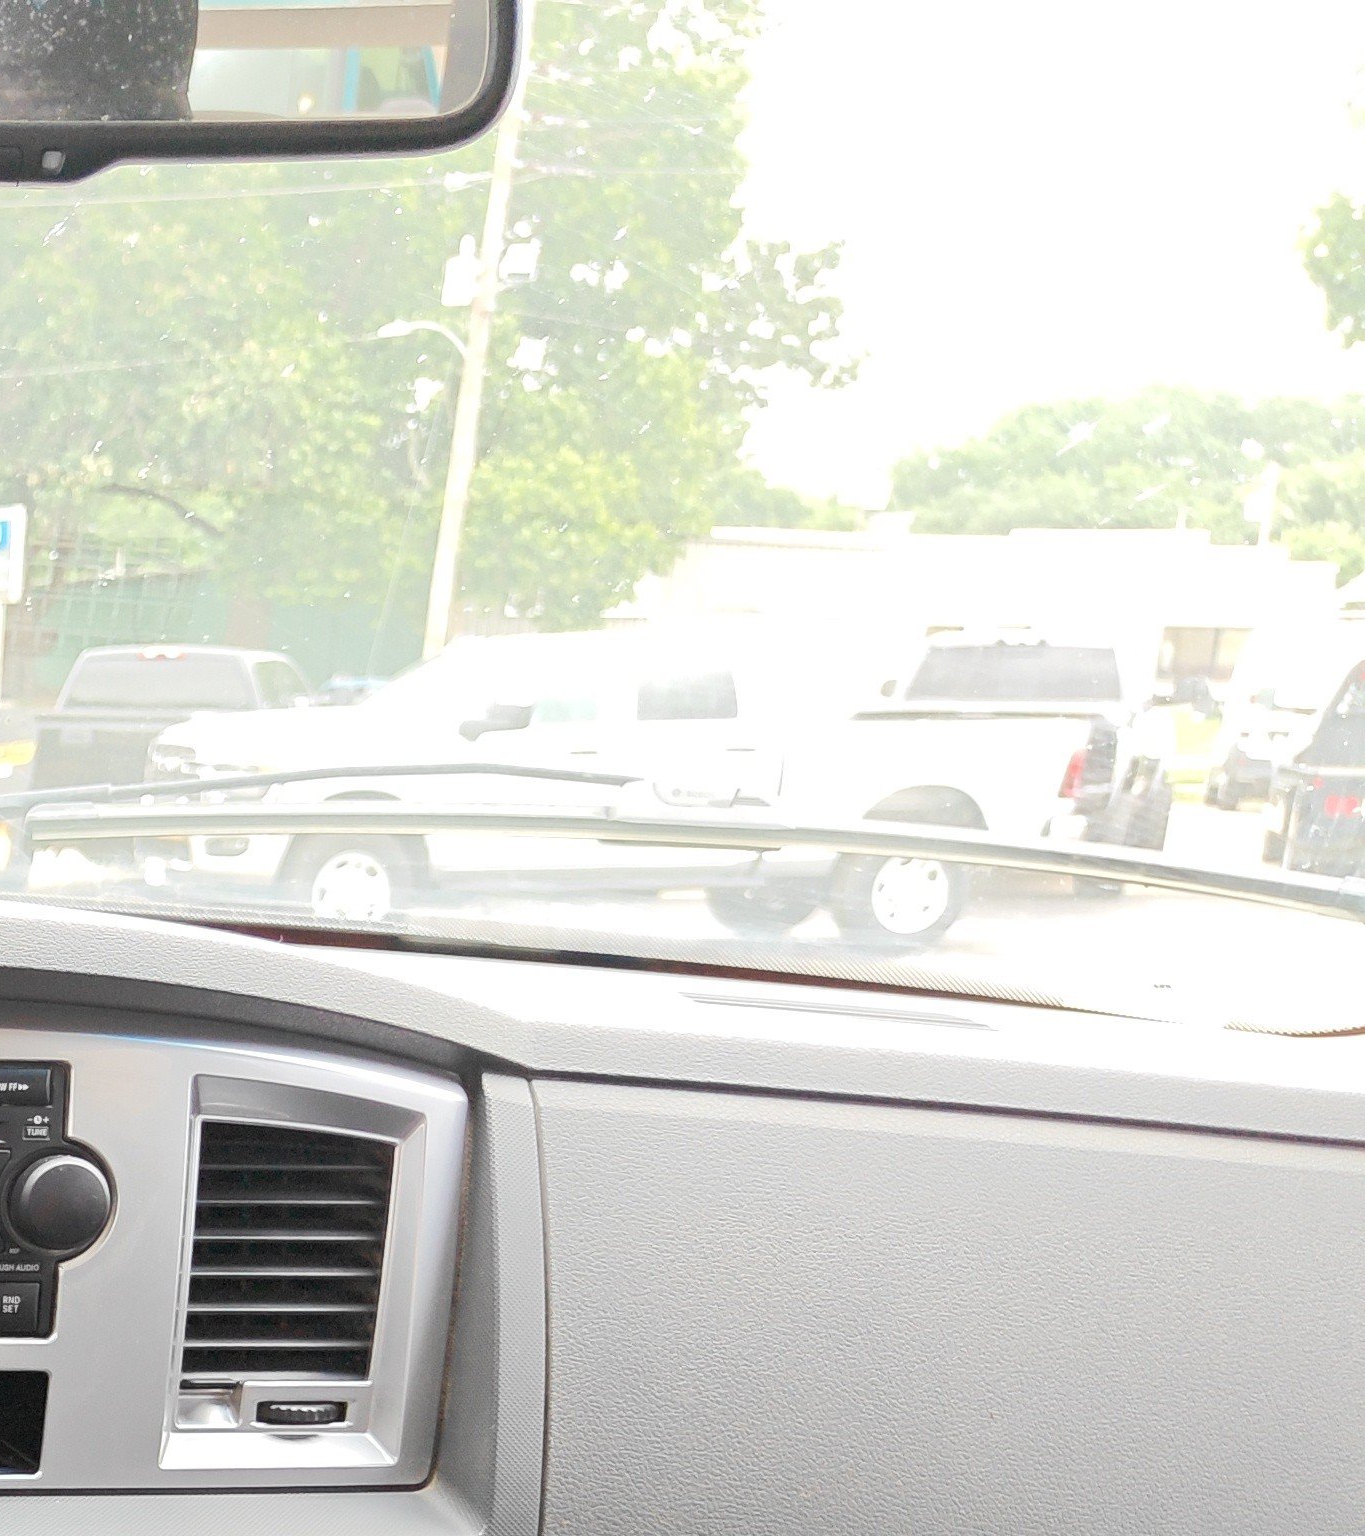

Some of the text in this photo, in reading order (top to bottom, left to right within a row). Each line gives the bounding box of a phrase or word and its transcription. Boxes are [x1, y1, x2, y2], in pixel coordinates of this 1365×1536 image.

[27, 1128, 48, 1137] TUNE
[15, 1264, 40, 1272] AUDIO
[2, 1295, 21, 1304] RND
[2, 1304, 19, 1313] SET
